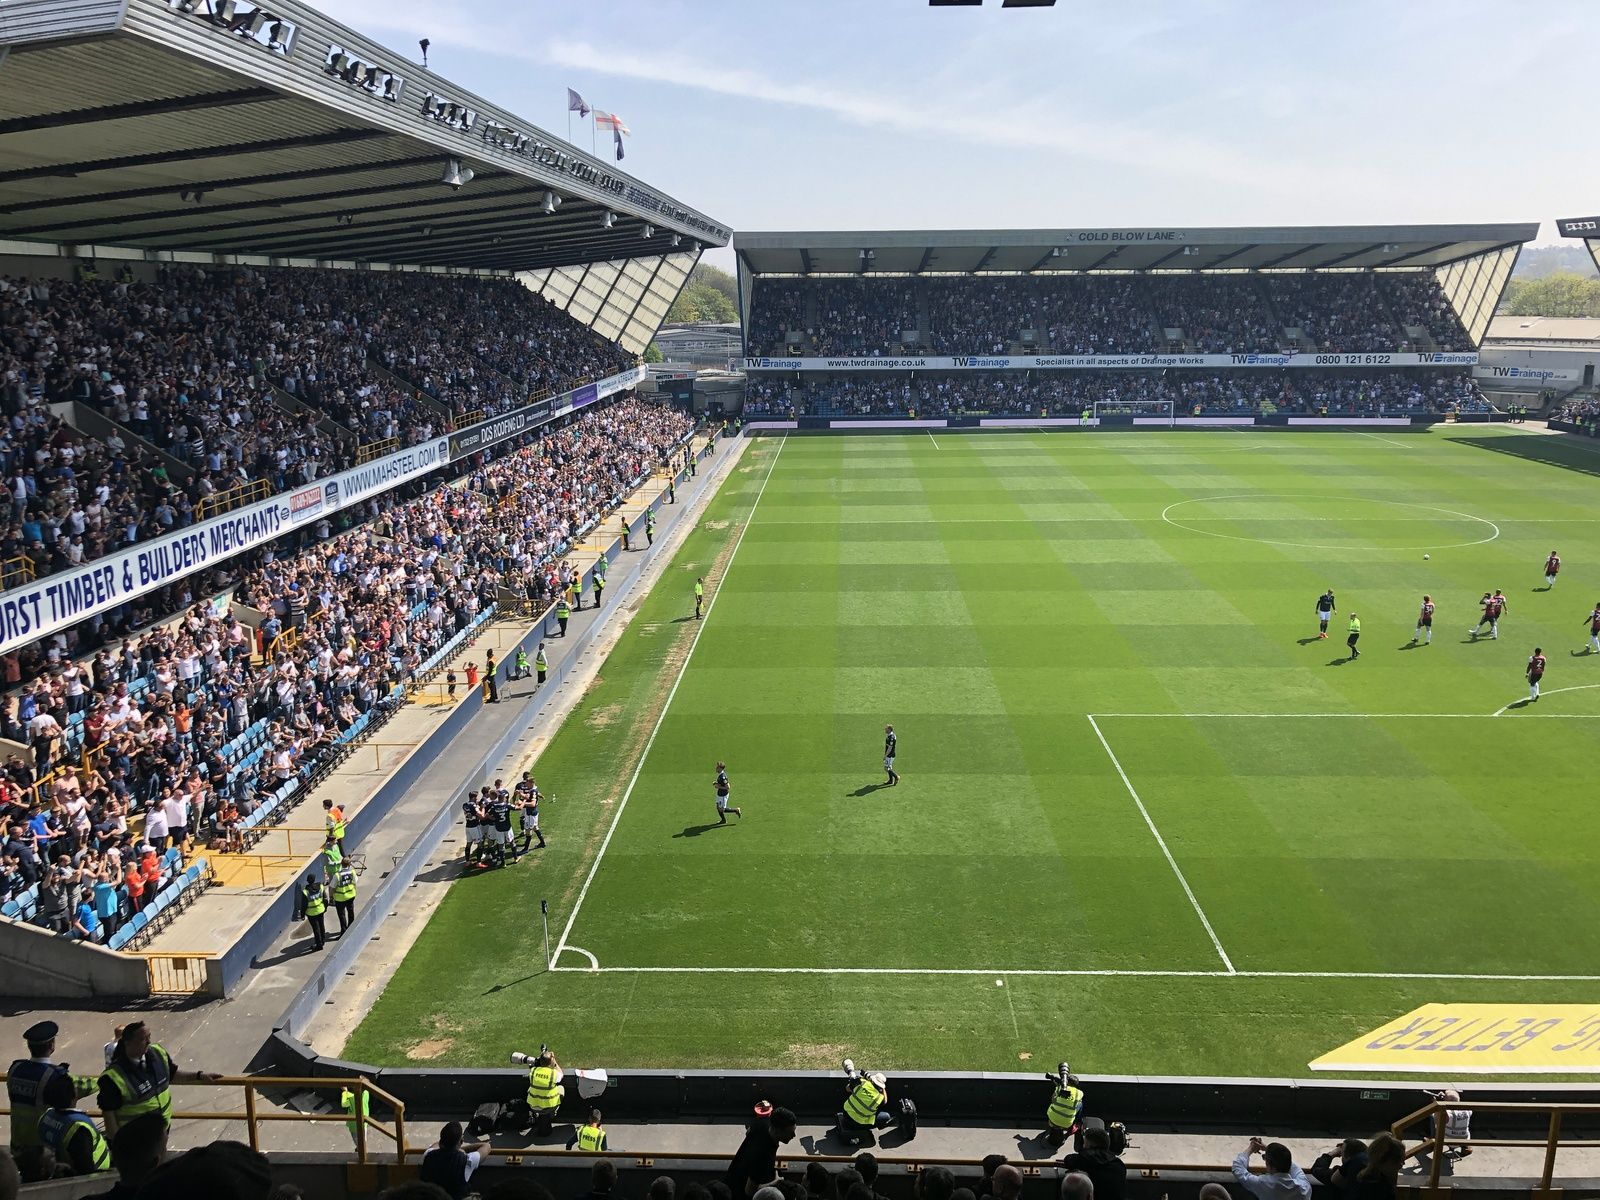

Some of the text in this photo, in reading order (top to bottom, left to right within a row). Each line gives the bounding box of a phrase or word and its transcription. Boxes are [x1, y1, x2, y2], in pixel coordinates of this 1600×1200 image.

[1078, 231, 1176, 242] COLD BLOW LANE
[827, 358, 926, 368] www.twdrainage.co.uk
[1035, 358, 1074, 367] Specialist
[1097, 358, 1129, 367] aspects
[1131, 357, 1140, 365] of
[1141, 357, 1177, 367] Drainage
[1179, 357, 1204, 365] Works
[1315, 355, 1391, 364] 0800 121 6122
[481, 425, 493, 443] DCS
[493, 416, 516, 439] ROOFING
[516, 414, 525, 429] LTD
[343, 446, 436, 498] WWW.MAHSTEEL.COM
[46, 564, 116, 622] TIMBER
[122, 559, 133, 593] &
[138, 531, 206, 587] BUILDERS
[209, 504, 280, 557] MERCHANTS
[499, 812, 506, 822] 3
[582, 1134, 596, 1142] PRESS
